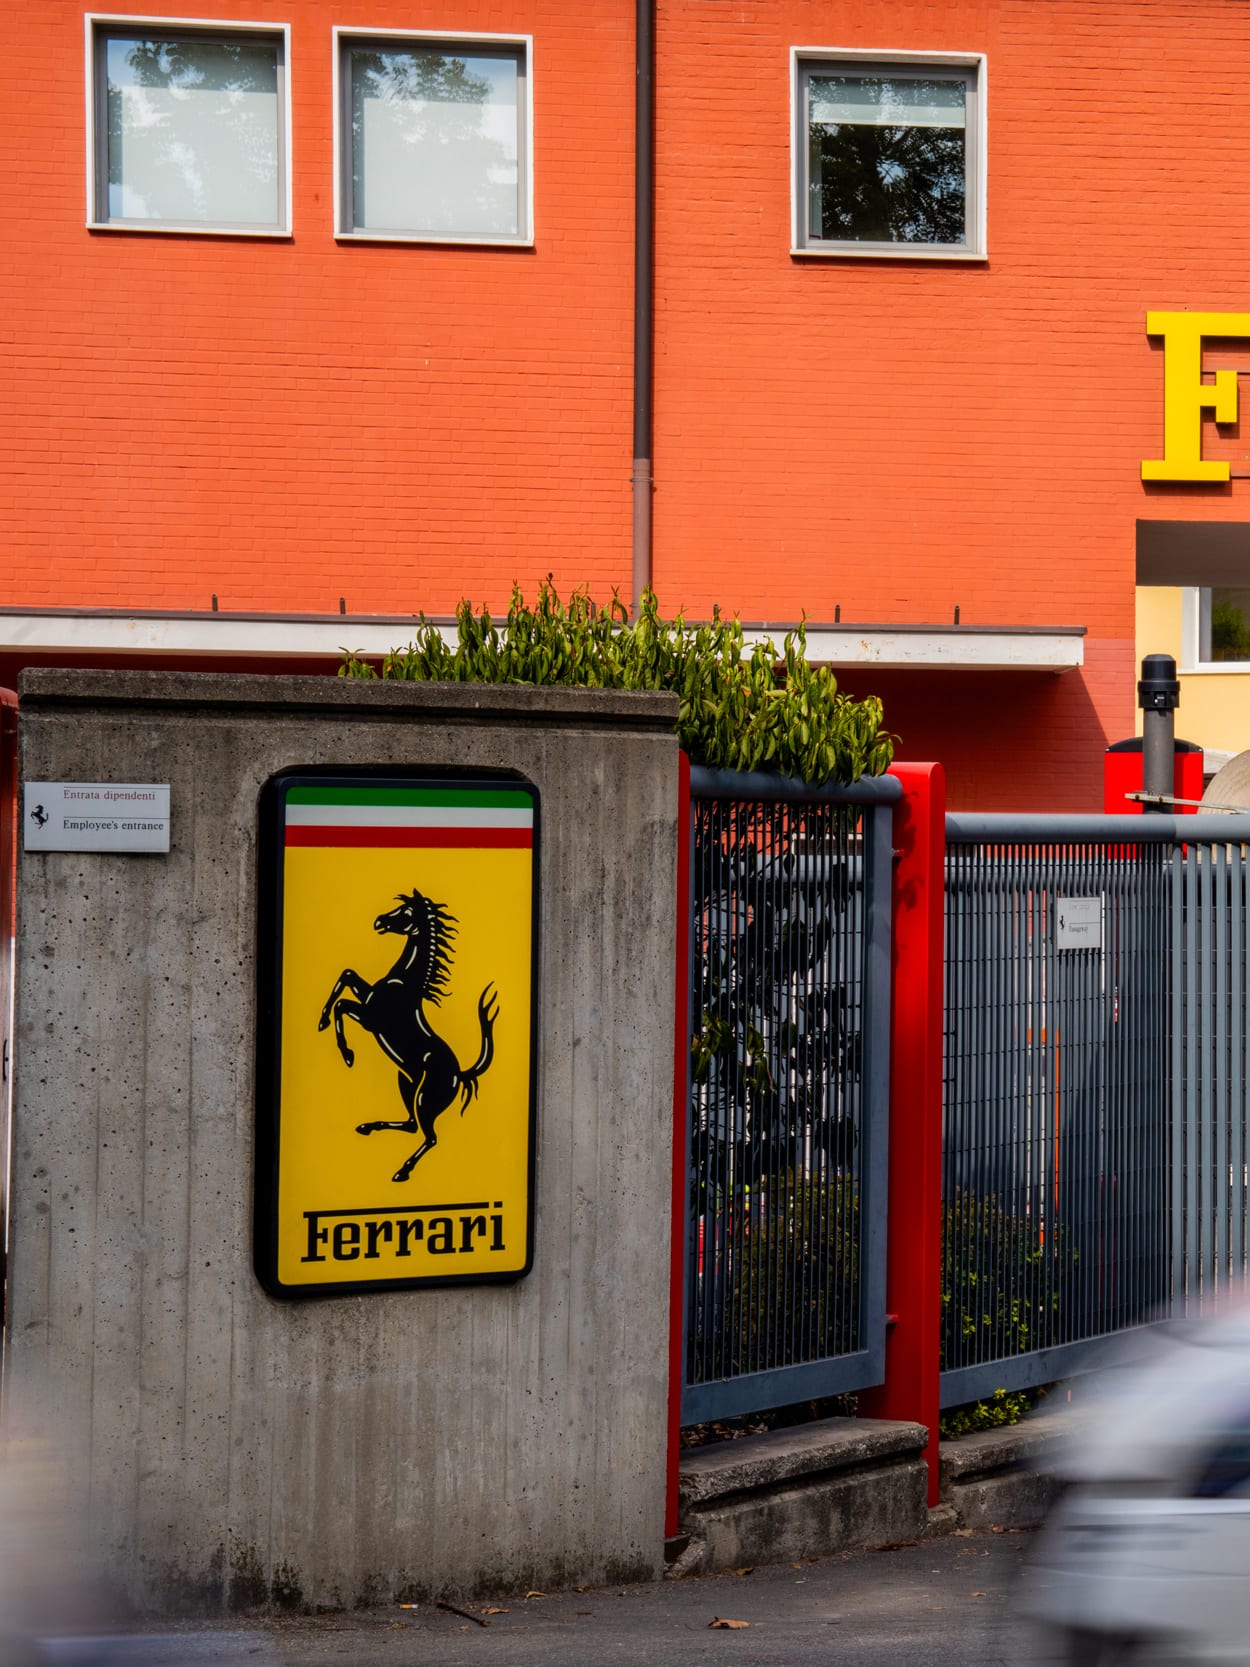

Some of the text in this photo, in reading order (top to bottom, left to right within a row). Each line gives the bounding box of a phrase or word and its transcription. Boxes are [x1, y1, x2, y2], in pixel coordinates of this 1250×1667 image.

[63, 789, 155, 801] Entrata dipendenti
[63, 820, 164, 831] Employee's entrance
[301, 1201, 505, 1262] Ferrari
